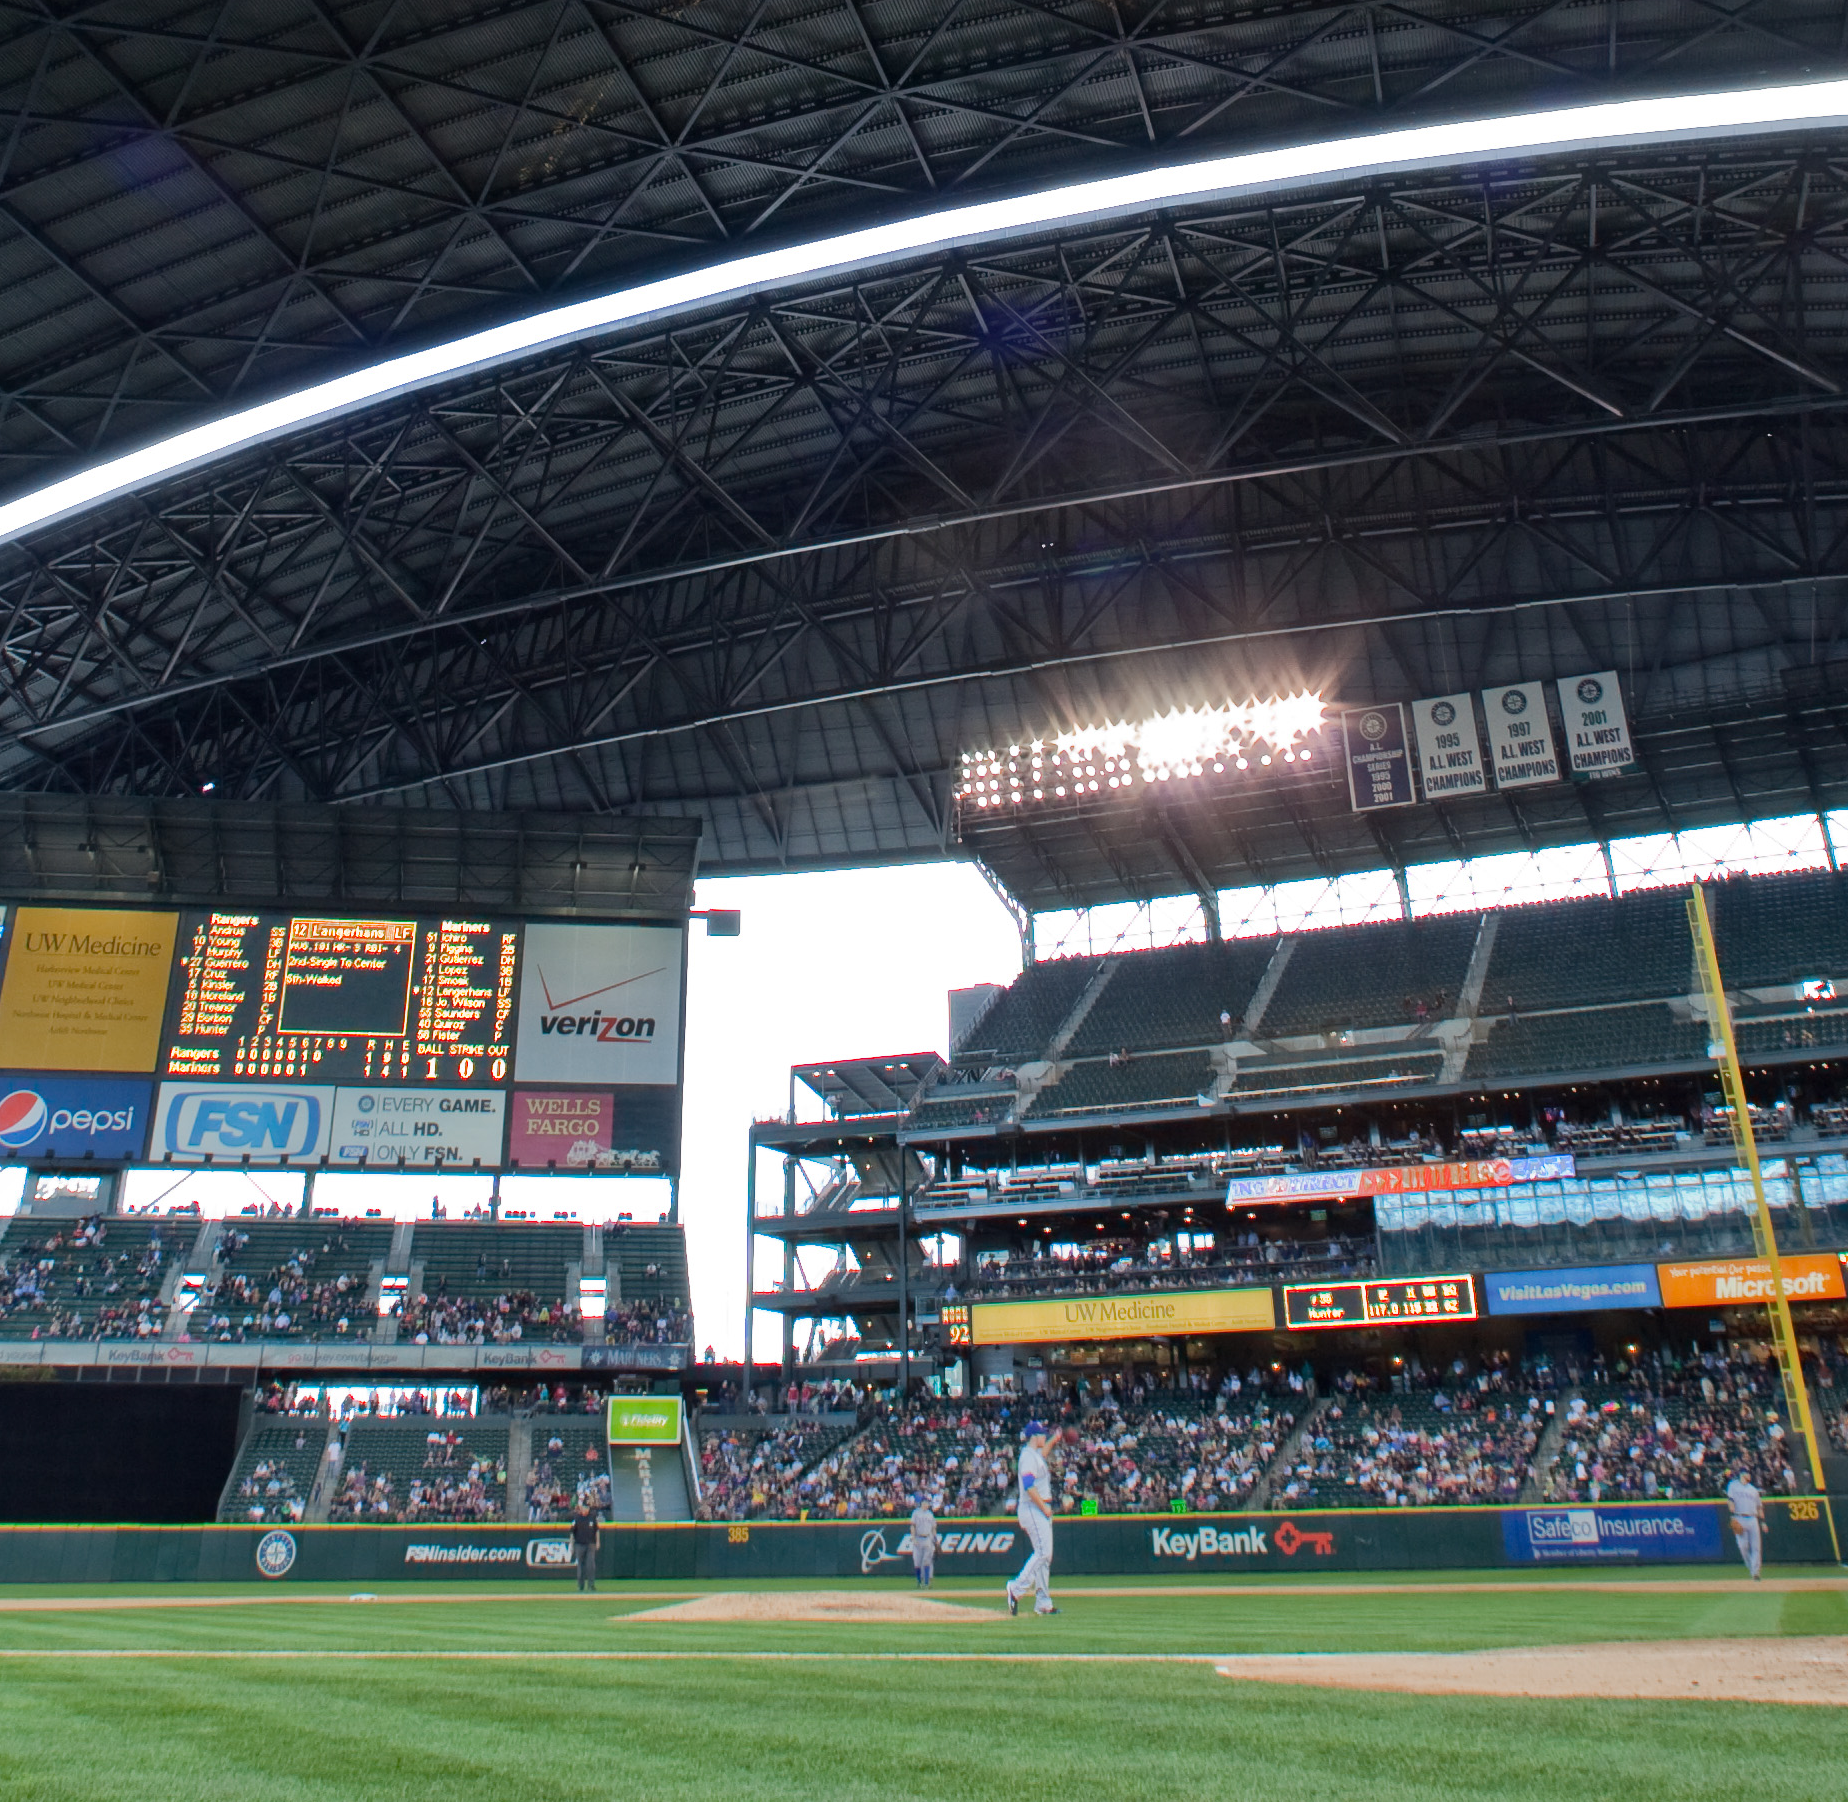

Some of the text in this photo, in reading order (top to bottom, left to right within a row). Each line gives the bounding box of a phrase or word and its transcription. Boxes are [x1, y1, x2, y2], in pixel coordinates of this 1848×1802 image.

[1582, 710, 1607, 726] 2001
[1507, 722, 1531, 738] 1997
[1577, 728, 1621, 748] A.L. WEST
[1435, 733, 1461, 749] 1995
[1501, 740, 1545, 760] A.L. WEST
[1429, 750, 1473, 770] A.L. WEST
[1574, 748, 1631, 768] CHAMPIONS
[1498, 759, 1556, 782] CHAMPIONS
[1426, 770, 1483, 792] CHAMPIONS
[211, 913, 259, 927] Rangers
[441, 920, 491, 934] Mariners
[209, 925, 246, 937] Andrus
[294, 924, 384, 940] 12 Langerhans
[26, 933, 161, 956] UW Medicine
[540, 1010, 655, 1042] verizon
[170, 1046, 220, 1060] Rangers
[417, 1044, 509, 1057] BALL STRIKE OUT
[168, 1061, 220, 1075] Mariners
[425, 1057, 507, 1081] 1 0 0
[382, 1097, 496, 1113] EVERY GAME.
[526, 1098, 601, 1115] WELLS
[49, 1106, 134, 1134] pepsi
[188, 1099, 299, 1149] FSN
[379, 1121, 443, 1136] ALL HD.
[526, 1119, 599, 1136] FARGO
[377, 1145, 463, 1161] ONLY FSN.
[1499, 1280, 1647, 1302] VisitLasVegas.com
[1064, 1300, 1175, 1324] UW Medicine
[950, 1324, 970, 1345] 92
[108, 1349, 164, 1364] KeyBank
[483, 1351, 537, 1366] KeyBank
[606, 1349, 662, 1367] MARINERS
[629, 1413, 669, 1428] Fidelity
[1788, 1501, 1819, 1521] 326
[728, 1526, 749, 1543] 385
[1532, 1515, 1592, 1539] Safeco
[896, 1532, 1015, 1554] BEING
[1152, 1526, 1268, 1562] KeyBank
[404, 1544, 522, 1564] FSNinsider.com
[534, 1542, 572, 1564] FSN
